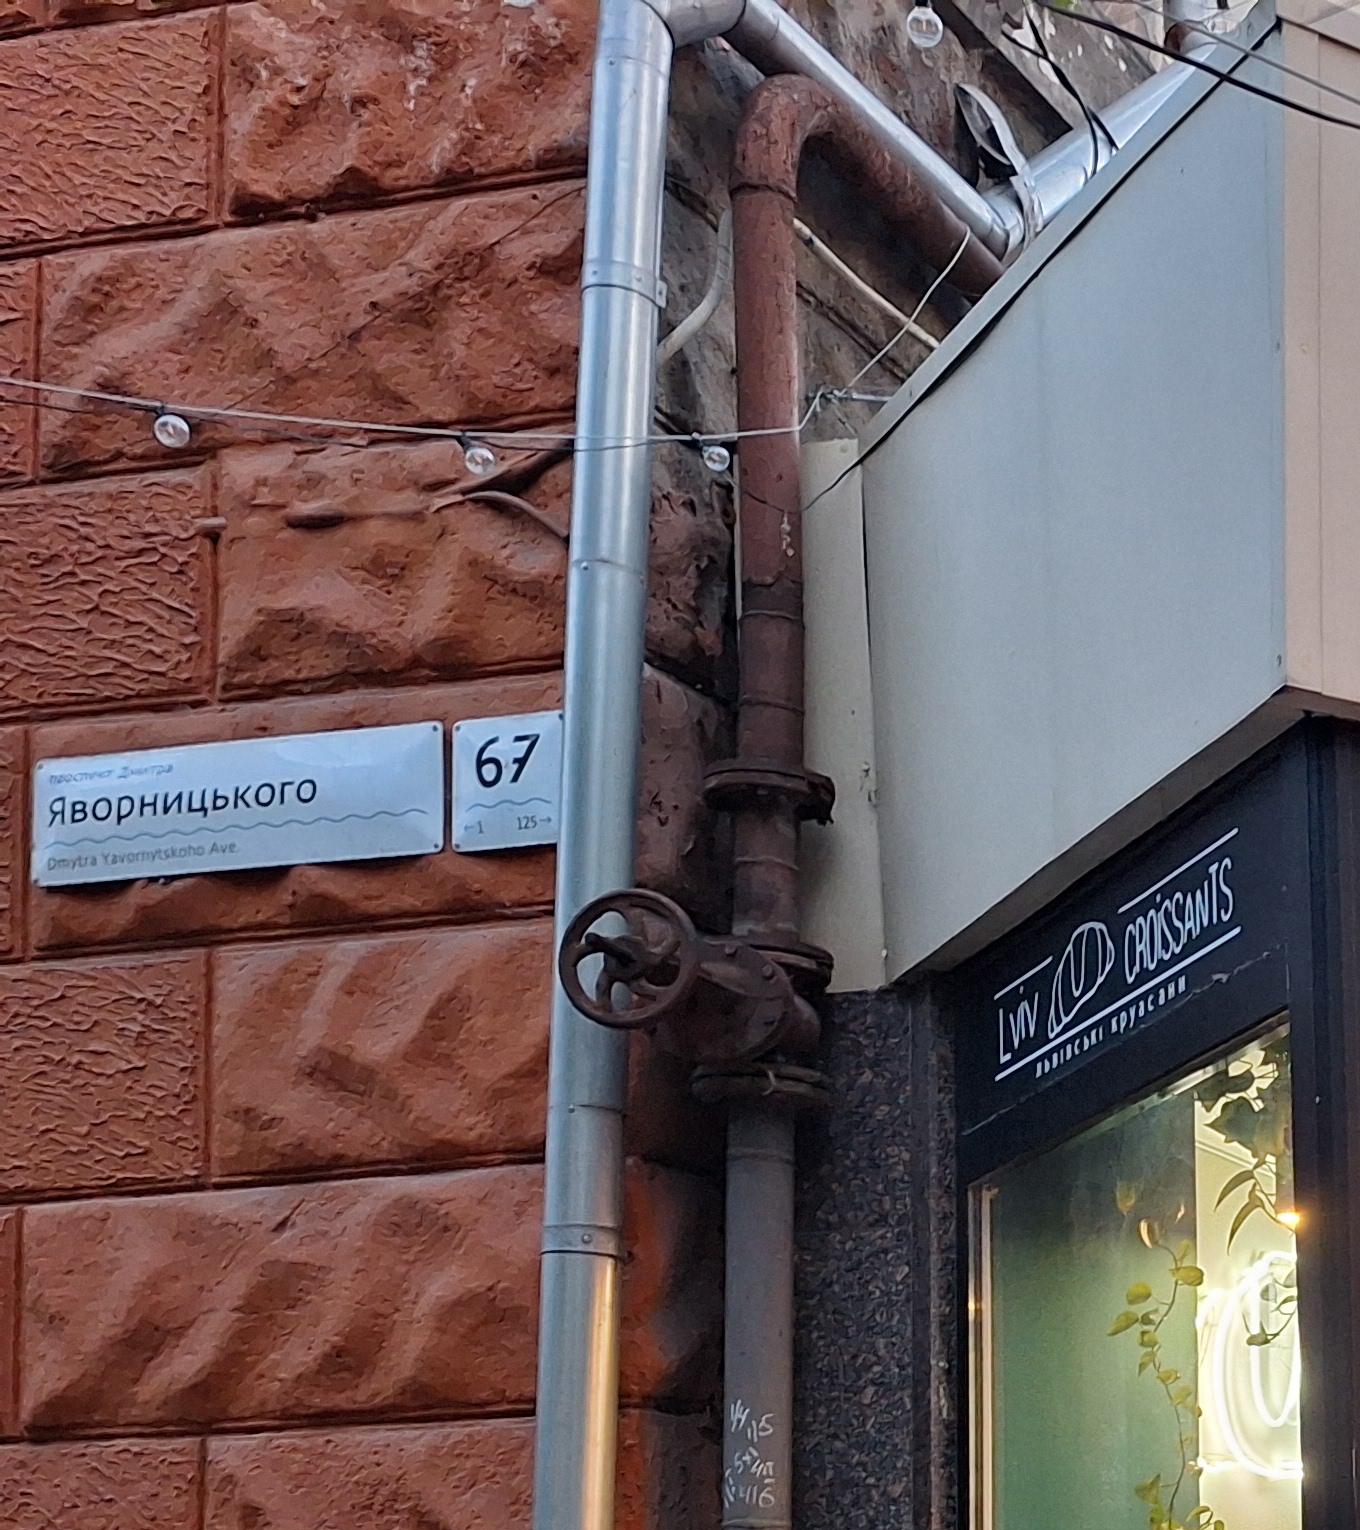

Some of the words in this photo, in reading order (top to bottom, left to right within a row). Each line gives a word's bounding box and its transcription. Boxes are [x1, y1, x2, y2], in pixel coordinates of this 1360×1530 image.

[475, 733, 541, 789] 67
[48, 778, 318, 828] Яворницького
[477, 820, 485, 835] 1
[516, 814, 539, 831] 125
[47, 855, 98, 872] Dmytra
[101, 843, 205, 867] Yavornytskoho
[1122, 855, 1235, 985] CROISSANTS
[1034, 1022, 1105, 1080] львівські
[1109, 973, 1188, 1035] круасани
